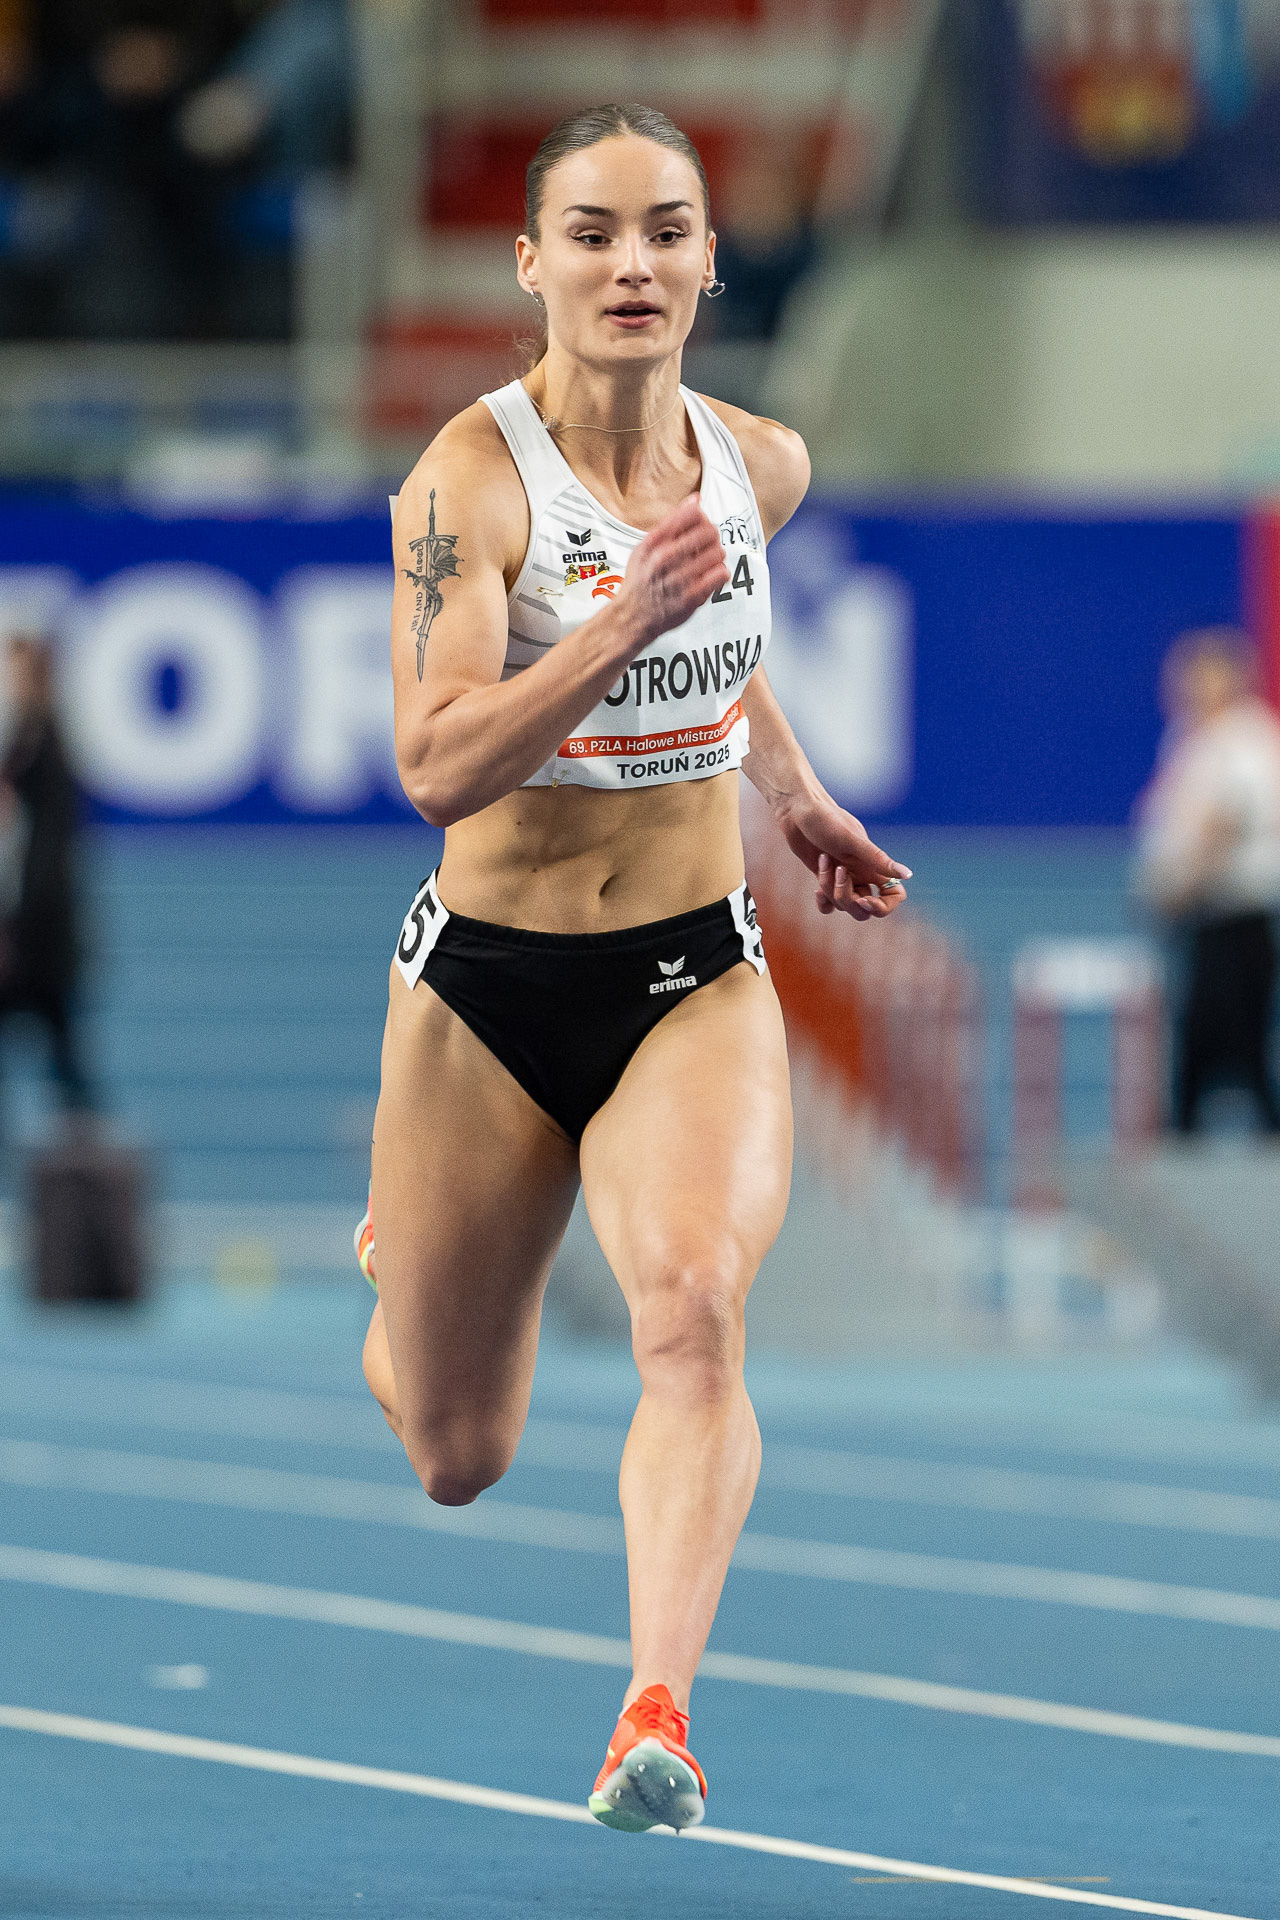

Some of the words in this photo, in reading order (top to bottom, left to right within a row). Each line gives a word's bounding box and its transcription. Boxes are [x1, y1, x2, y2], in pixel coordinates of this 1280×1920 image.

[562, 550, 607, 564] erima
[415, 591, 423, 611] AND
[602, 634, 762, 707] OTROWSKA
[569, 741, 588, 754] 69.
[590, 739, 622, 753] PZLA
[626, 735, 675, 752] Halowe
[616, 751, 689, 780] TORUŃ
[694, 744, 730, 770] 2025
[398, 888, 437, 964] 5
[649, 975, 697, 994] erima
